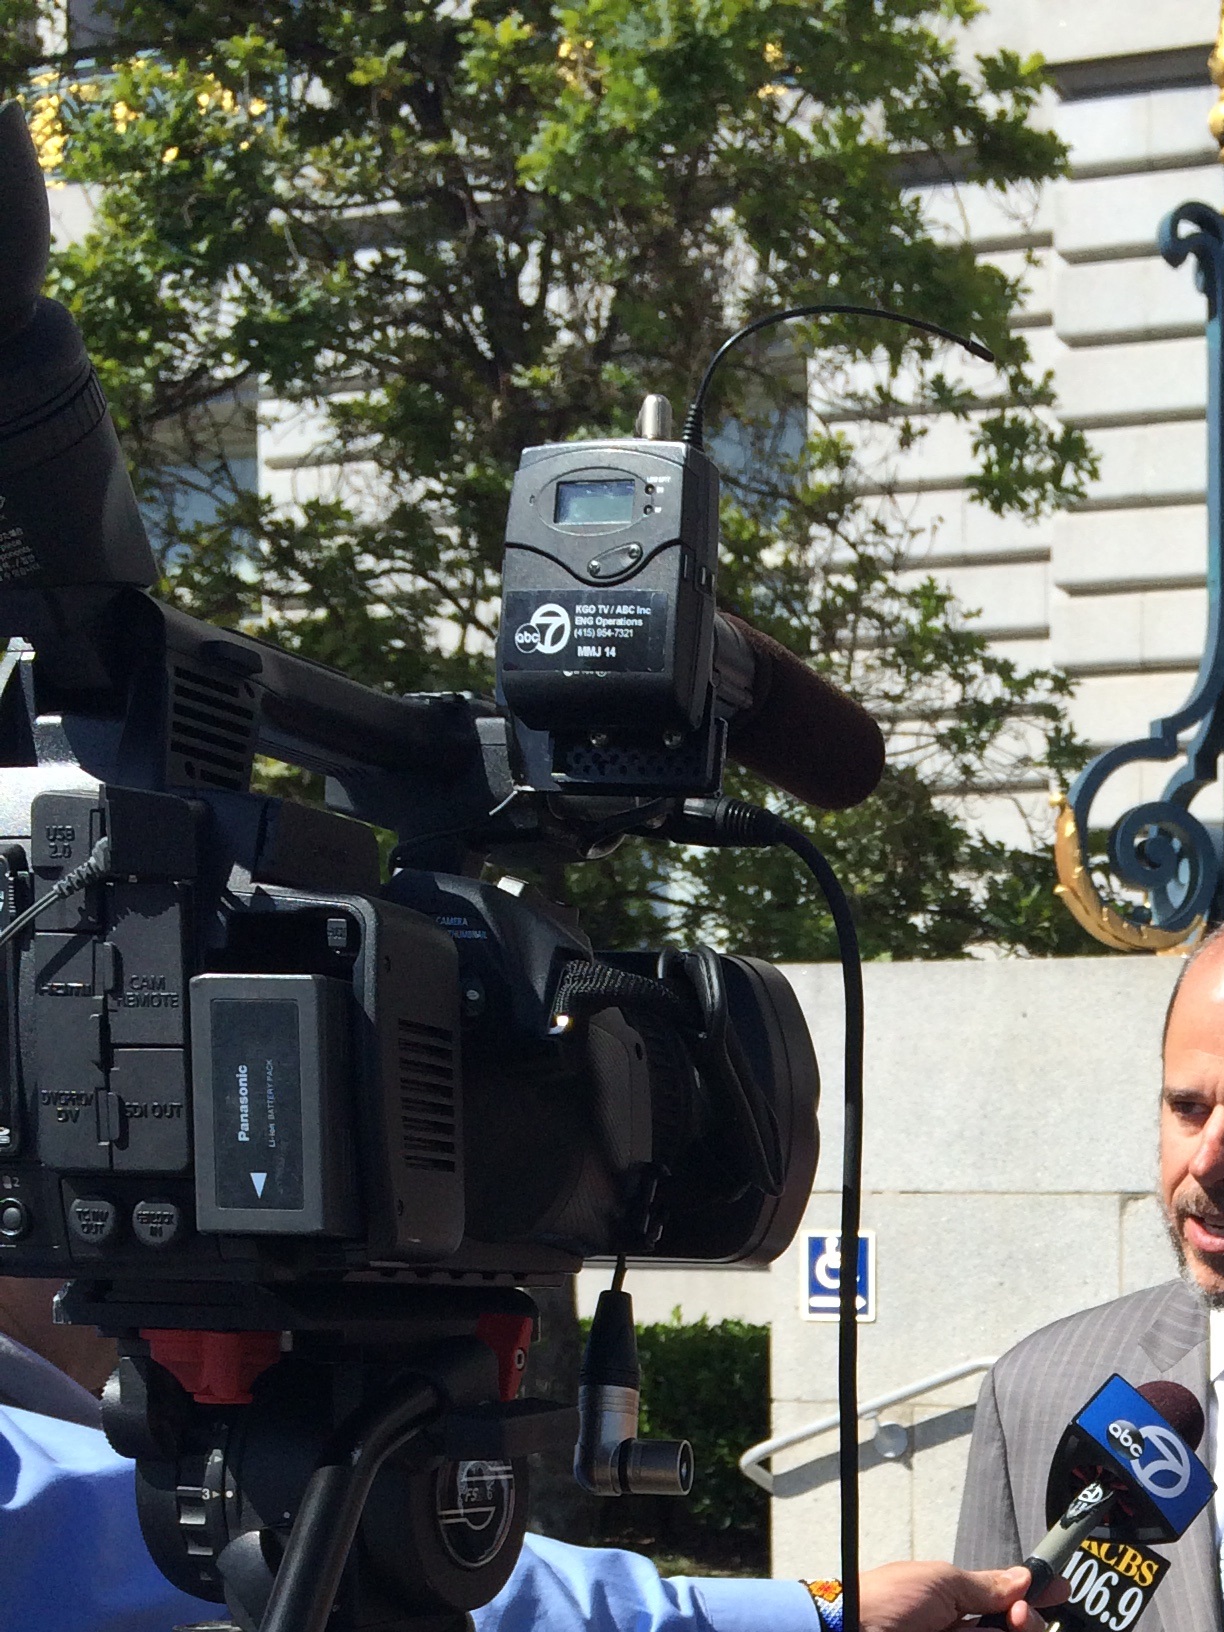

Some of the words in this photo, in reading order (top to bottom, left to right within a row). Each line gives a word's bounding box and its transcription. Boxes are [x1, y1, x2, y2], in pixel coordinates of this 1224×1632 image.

[576, 605, 596, 614] KGO
[598, 605, 610, 614] TV
[616, 605, 635, 615] ABC
[517, 631, 540, 643] abc
[530, 603, 571, 654] 7
[574, 617, 594, 625] ENG
[595, 617, 643, 627] Operations
[574, 628, 595, 638] (415)
[577, 646, 601, 657] MMJ
[604, 647, 616, 657] 14
[45, 825, 75, 842] USB
[49, 842, 72, 859] 2.0
[129, 975, 167, 990] CAM
[266, 1059, 274, 1082] PACK
[236, 1064, 250, 1142] Panasonic
[266, 1083, 275, 1120] BATTERY
[152, 1102, 183, 1119] OUT
[1108, 1423, 1143, 1457] abc
[1130, 1425, 1190, 1498] 7
[1080, 1539, 1160, 1586] KCBS
[1062, 1550, 1143, 1631] 106.9
